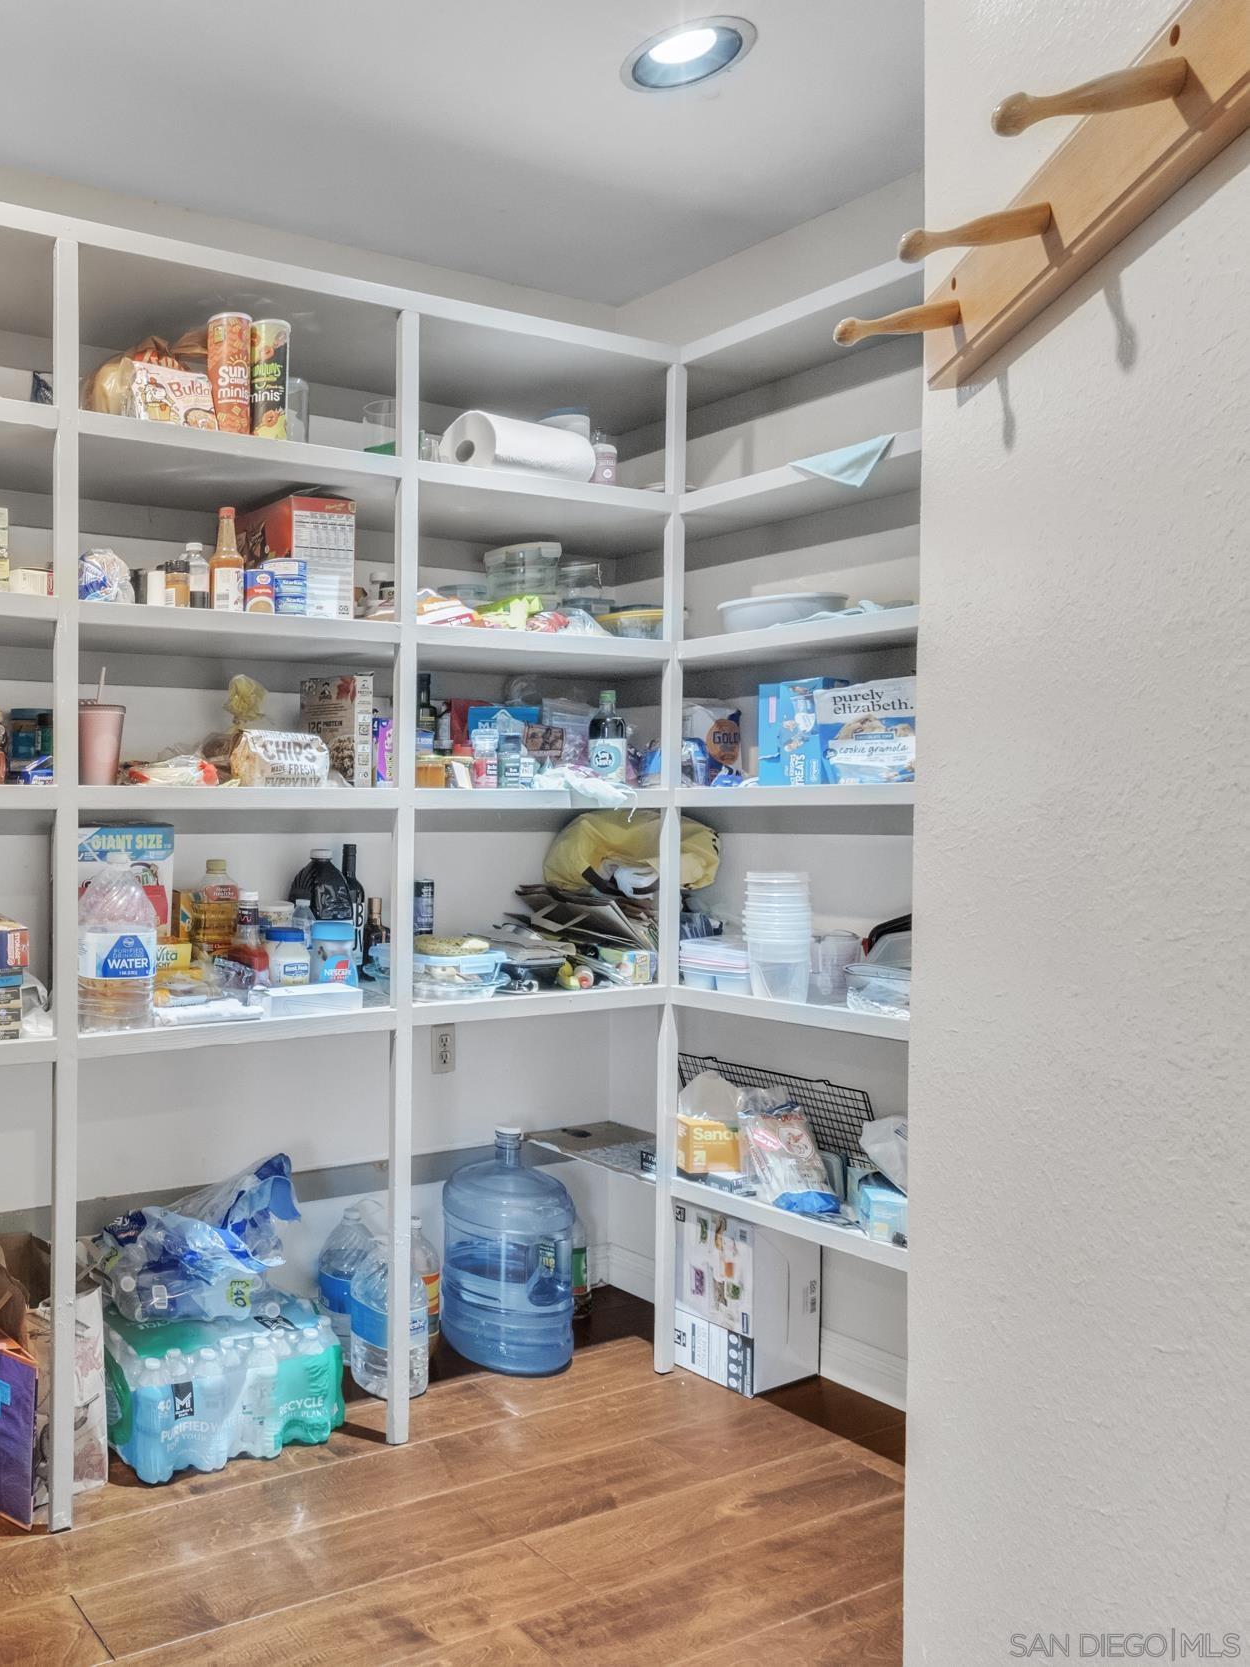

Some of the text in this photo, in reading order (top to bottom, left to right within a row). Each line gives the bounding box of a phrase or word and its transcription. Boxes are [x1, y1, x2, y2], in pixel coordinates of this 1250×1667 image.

[217, 364, 248, 386] Sun
[167, 378, 211, 399] Bulda
[217, 386, 250, 400] minis
[832, 689, 885, 706] purely
[833, 698, 914, 715] elizabeth.
[262, 740, 318, 763] CHIPS
[839, 742, 910, 757] cookie granola
[270, 763, 317, 776] MADE FRESH
[91, 833, 164, 850] GIANT SIZE
[155, 946, 178, 962] Vita
[106, 957, 149, 970] WATER
[692, 1126, 736, 1142] Sand
[278, 1395, 325, 1417] RECYCLE
[160, 1420, 210, 1443] PURIFIED
